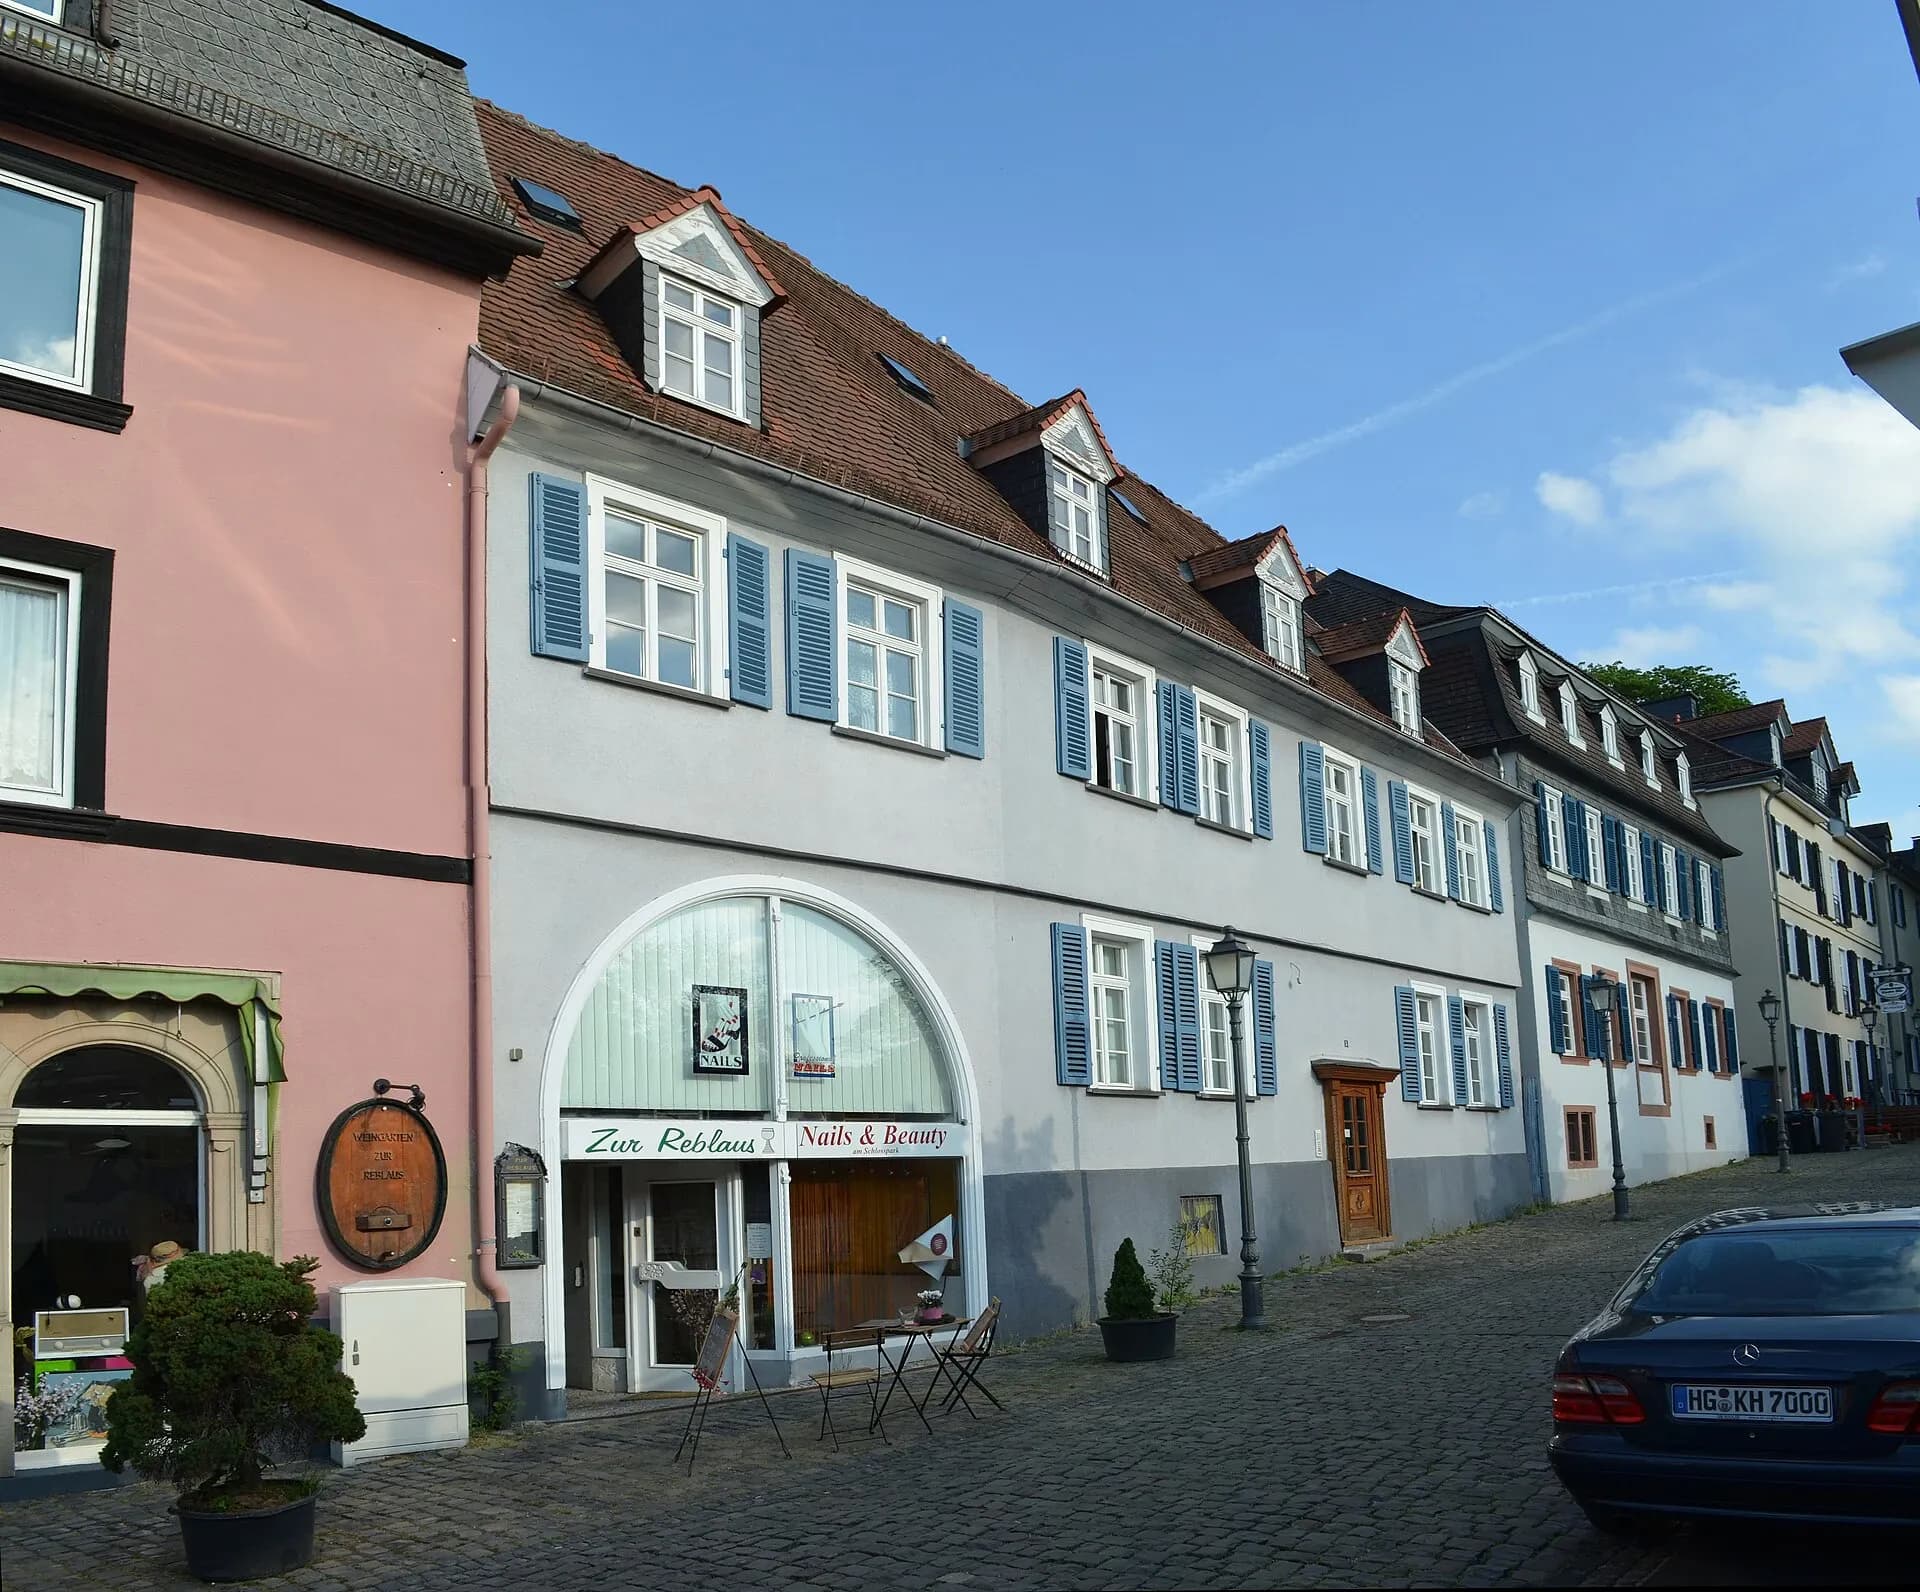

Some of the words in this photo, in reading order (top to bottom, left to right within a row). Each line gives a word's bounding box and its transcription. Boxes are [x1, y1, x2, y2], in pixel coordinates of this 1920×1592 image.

[700, 1056, 743, 1068] NAILS
[793, 1062, 835, 1073] NAILS
[352, 1132, 414, 1143] WEINGARTEN
[585, 1128, 644, 1154] Zur
[657, 1127, 755, 1154] Reblaus
[800, 1125, 852, 1147] Nails
[860, 1125, 875, 1146] &
[884, 1125, 947, 1150] Beauty
[374, 1151, 393, 1161] ZUR
[363, 1170, 405, 1181] REBLAUS
[1689, 1389, 1717, 1411] HG
[1735, 1390, 1764, 1412] KH
[1770, 1391, 1828, 1414] 7000
